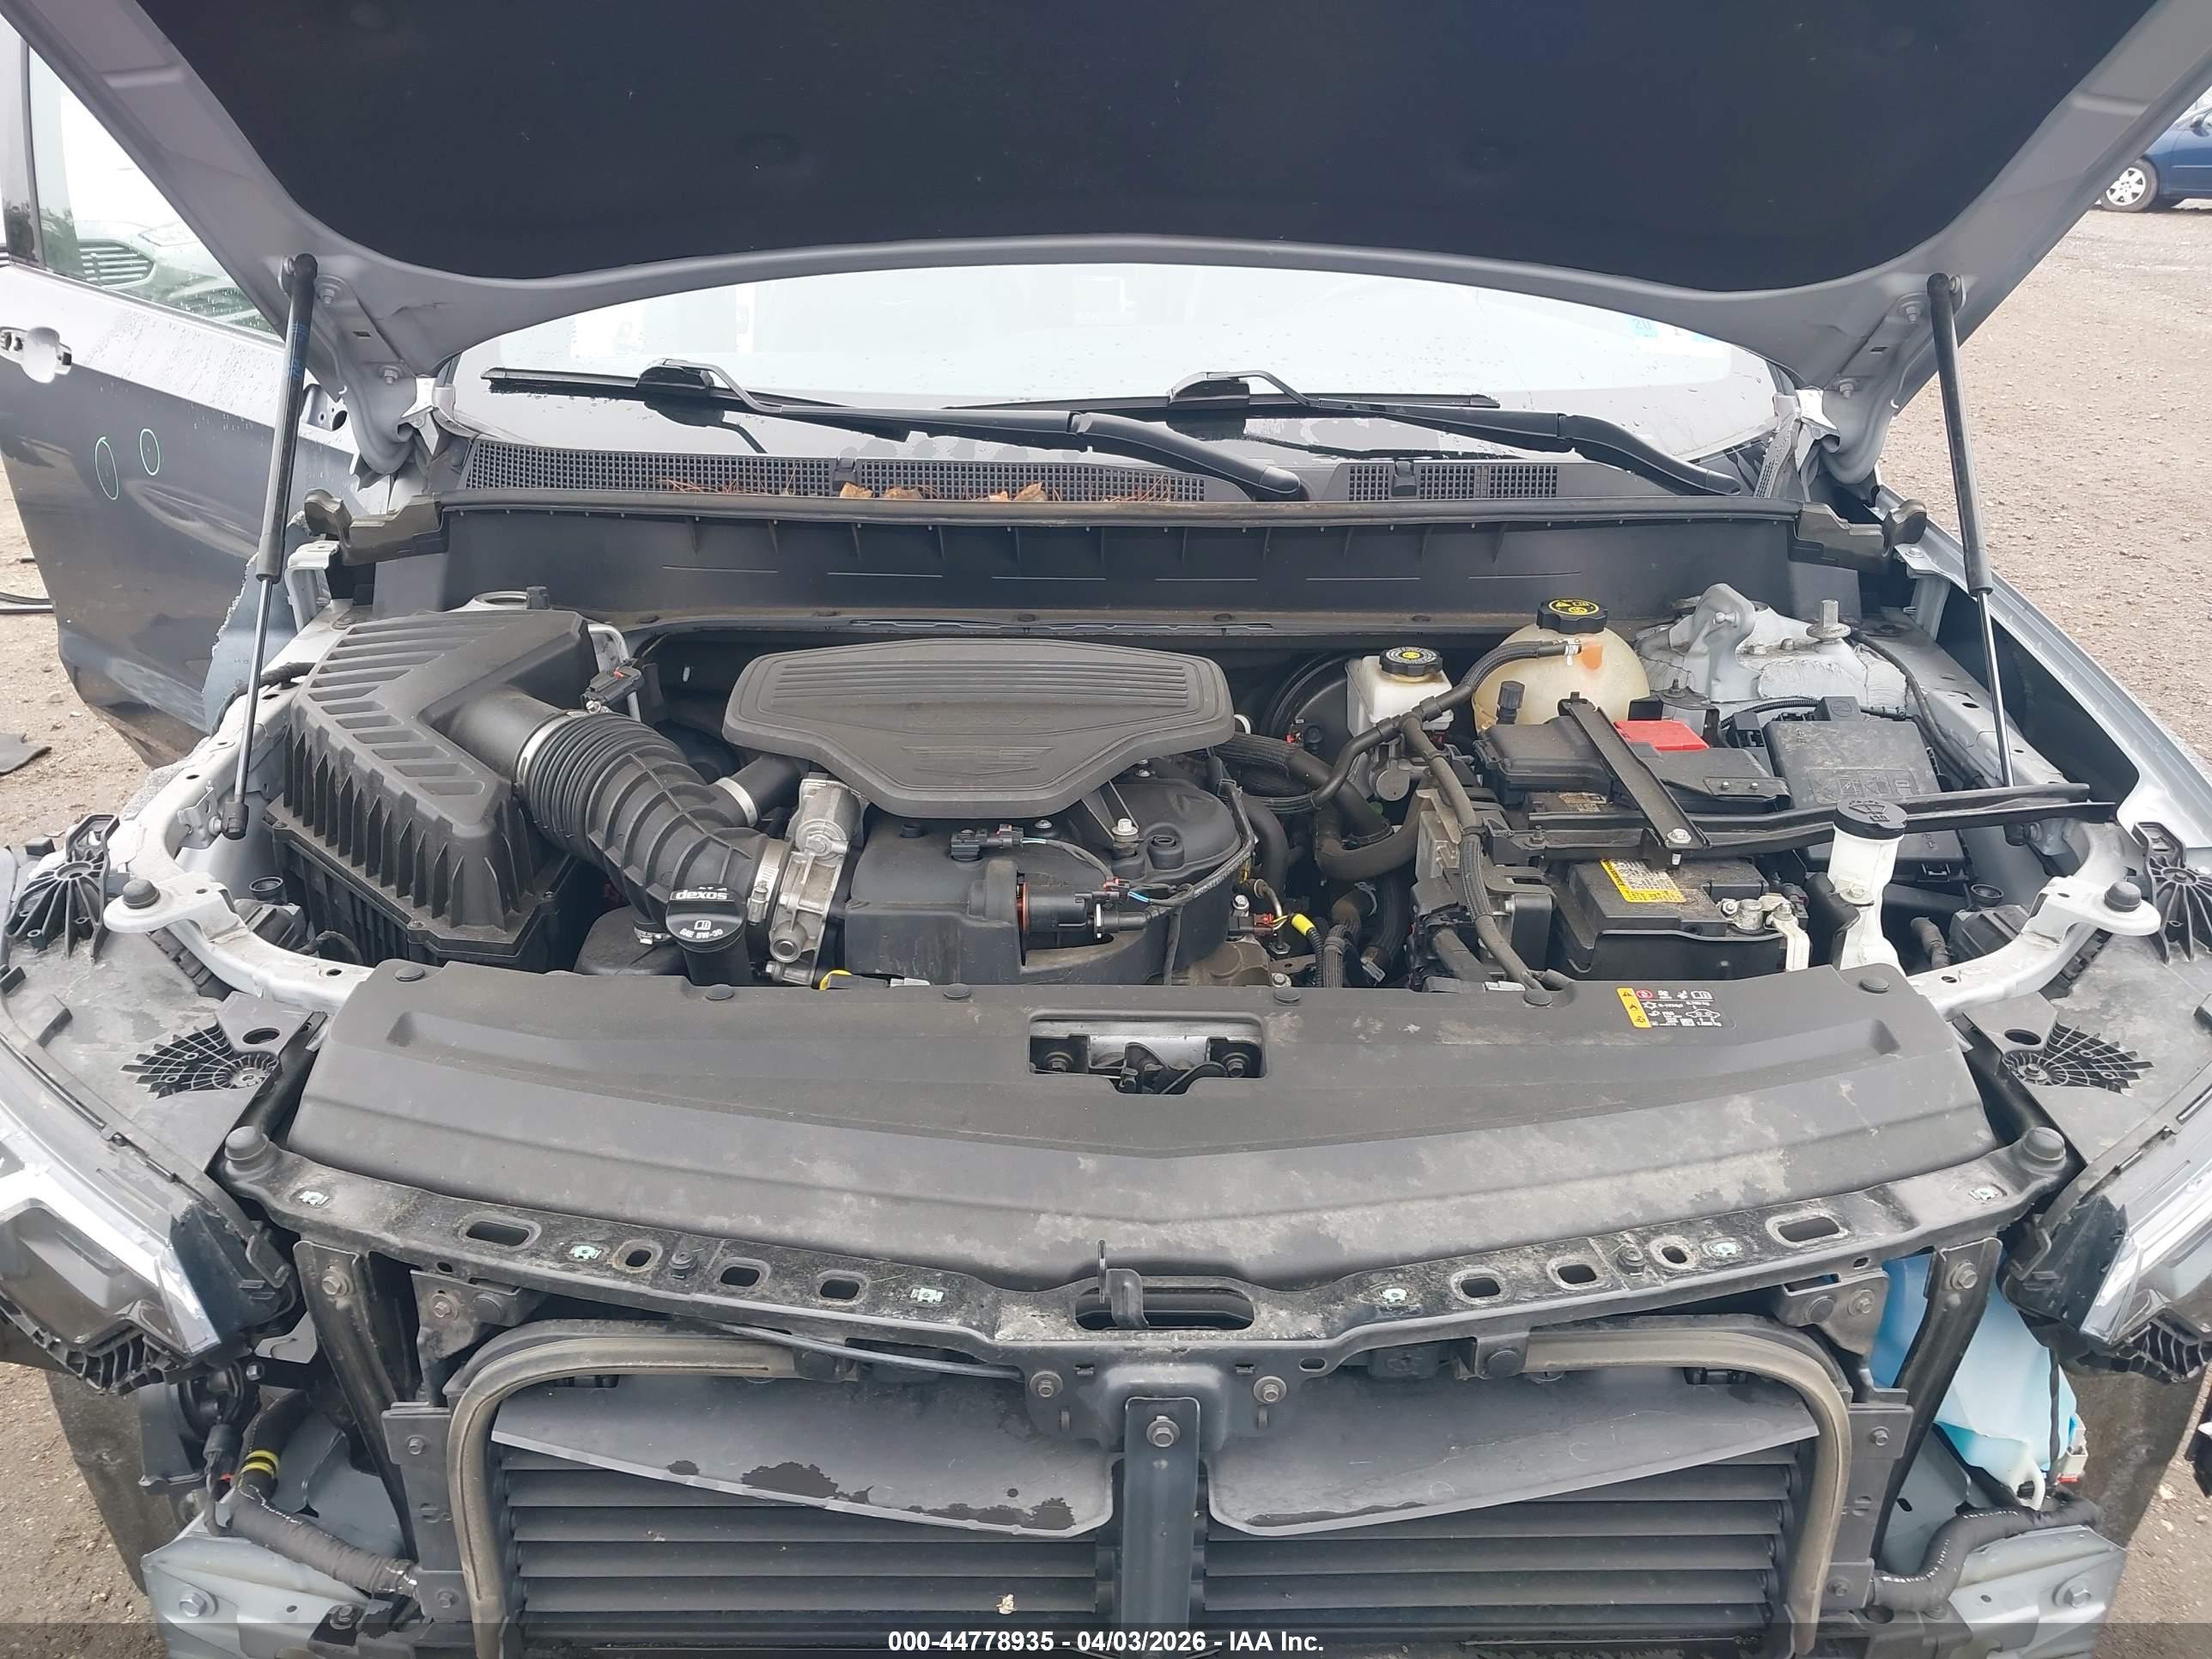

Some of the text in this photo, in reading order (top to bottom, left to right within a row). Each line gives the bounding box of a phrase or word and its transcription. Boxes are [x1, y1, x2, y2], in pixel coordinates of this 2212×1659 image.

[676, 890, 728, 900] dexos
[679, 928, 723, 939] SAE 5W-30
